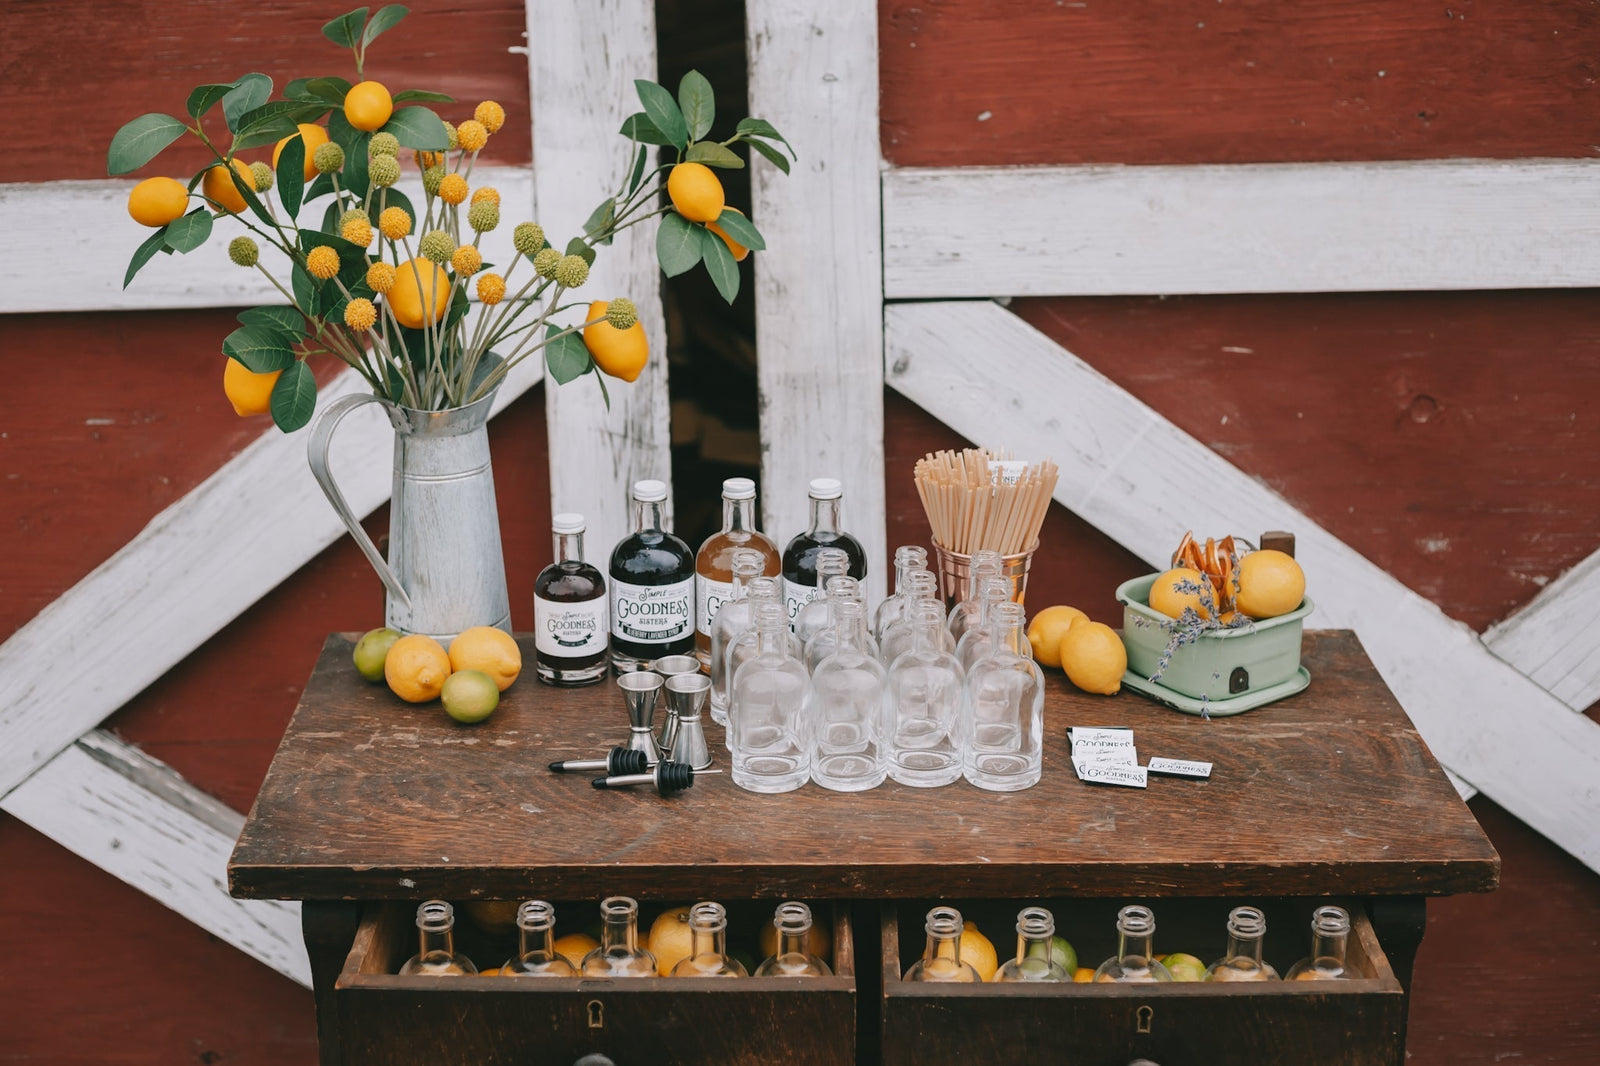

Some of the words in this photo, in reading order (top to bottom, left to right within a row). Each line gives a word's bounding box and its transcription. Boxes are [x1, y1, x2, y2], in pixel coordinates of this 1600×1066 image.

[617, 596, 688, 618] GOODNESS
[547, 617, 596, 632] GOODNESS
[639, 618, 668, 626] SISTERS
[1087, 768, 1145, 783] GOODNESS
